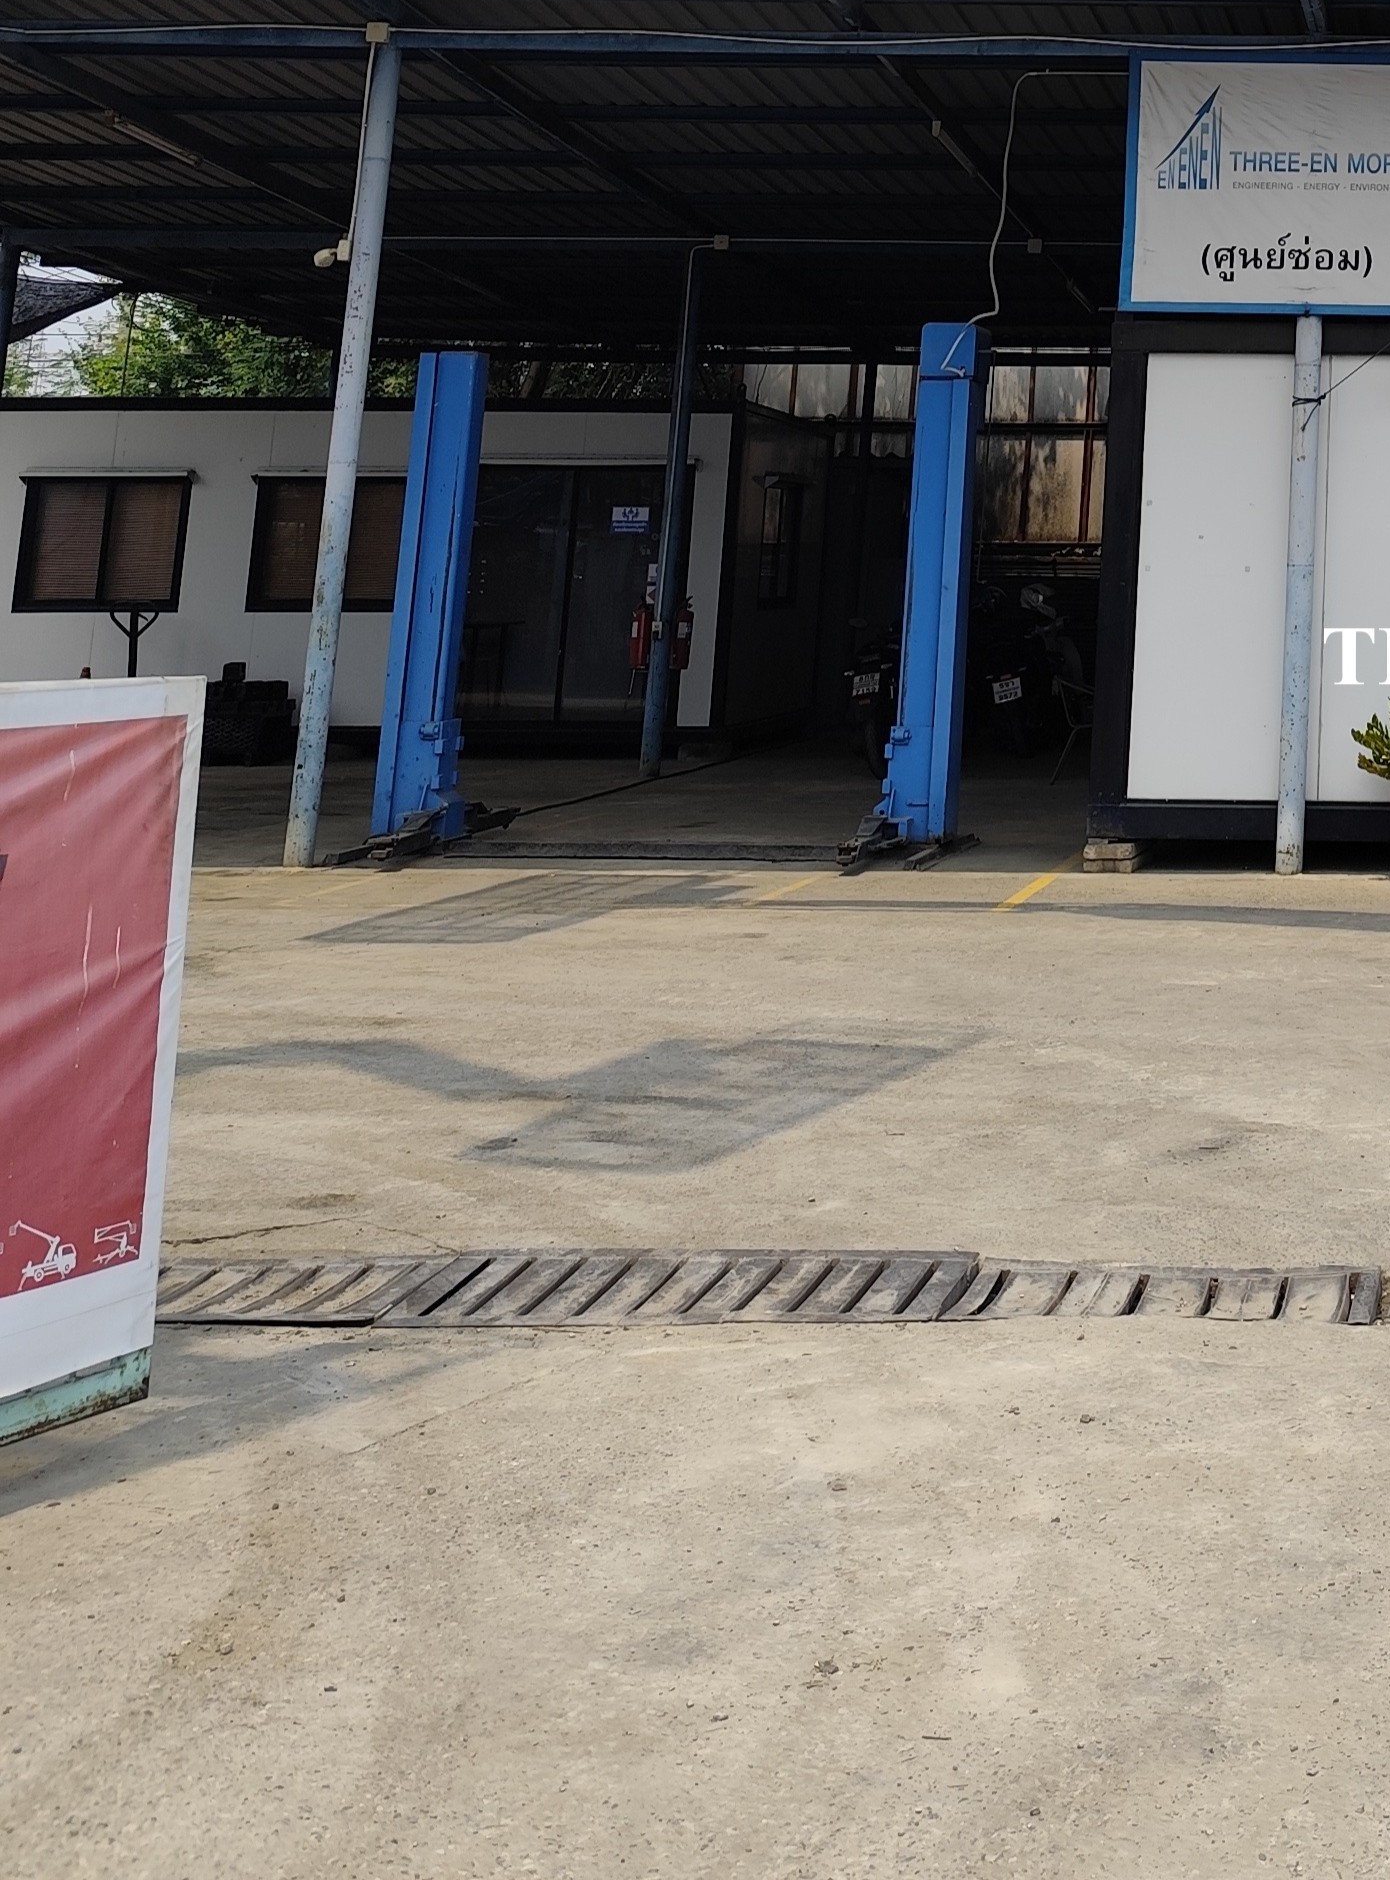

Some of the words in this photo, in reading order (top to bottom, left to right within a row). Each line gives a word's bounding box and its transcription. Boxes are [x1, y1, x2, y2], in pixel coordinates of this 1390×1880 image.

[1229, 151, 1338, 173] THREE-EN
[1232, 181, 1294, 190] ENGINEERING
[1303, 182, 1340, 191] ENERGY
[1202, 232, 1373, 282] (ศูนย์ซ่อม)
